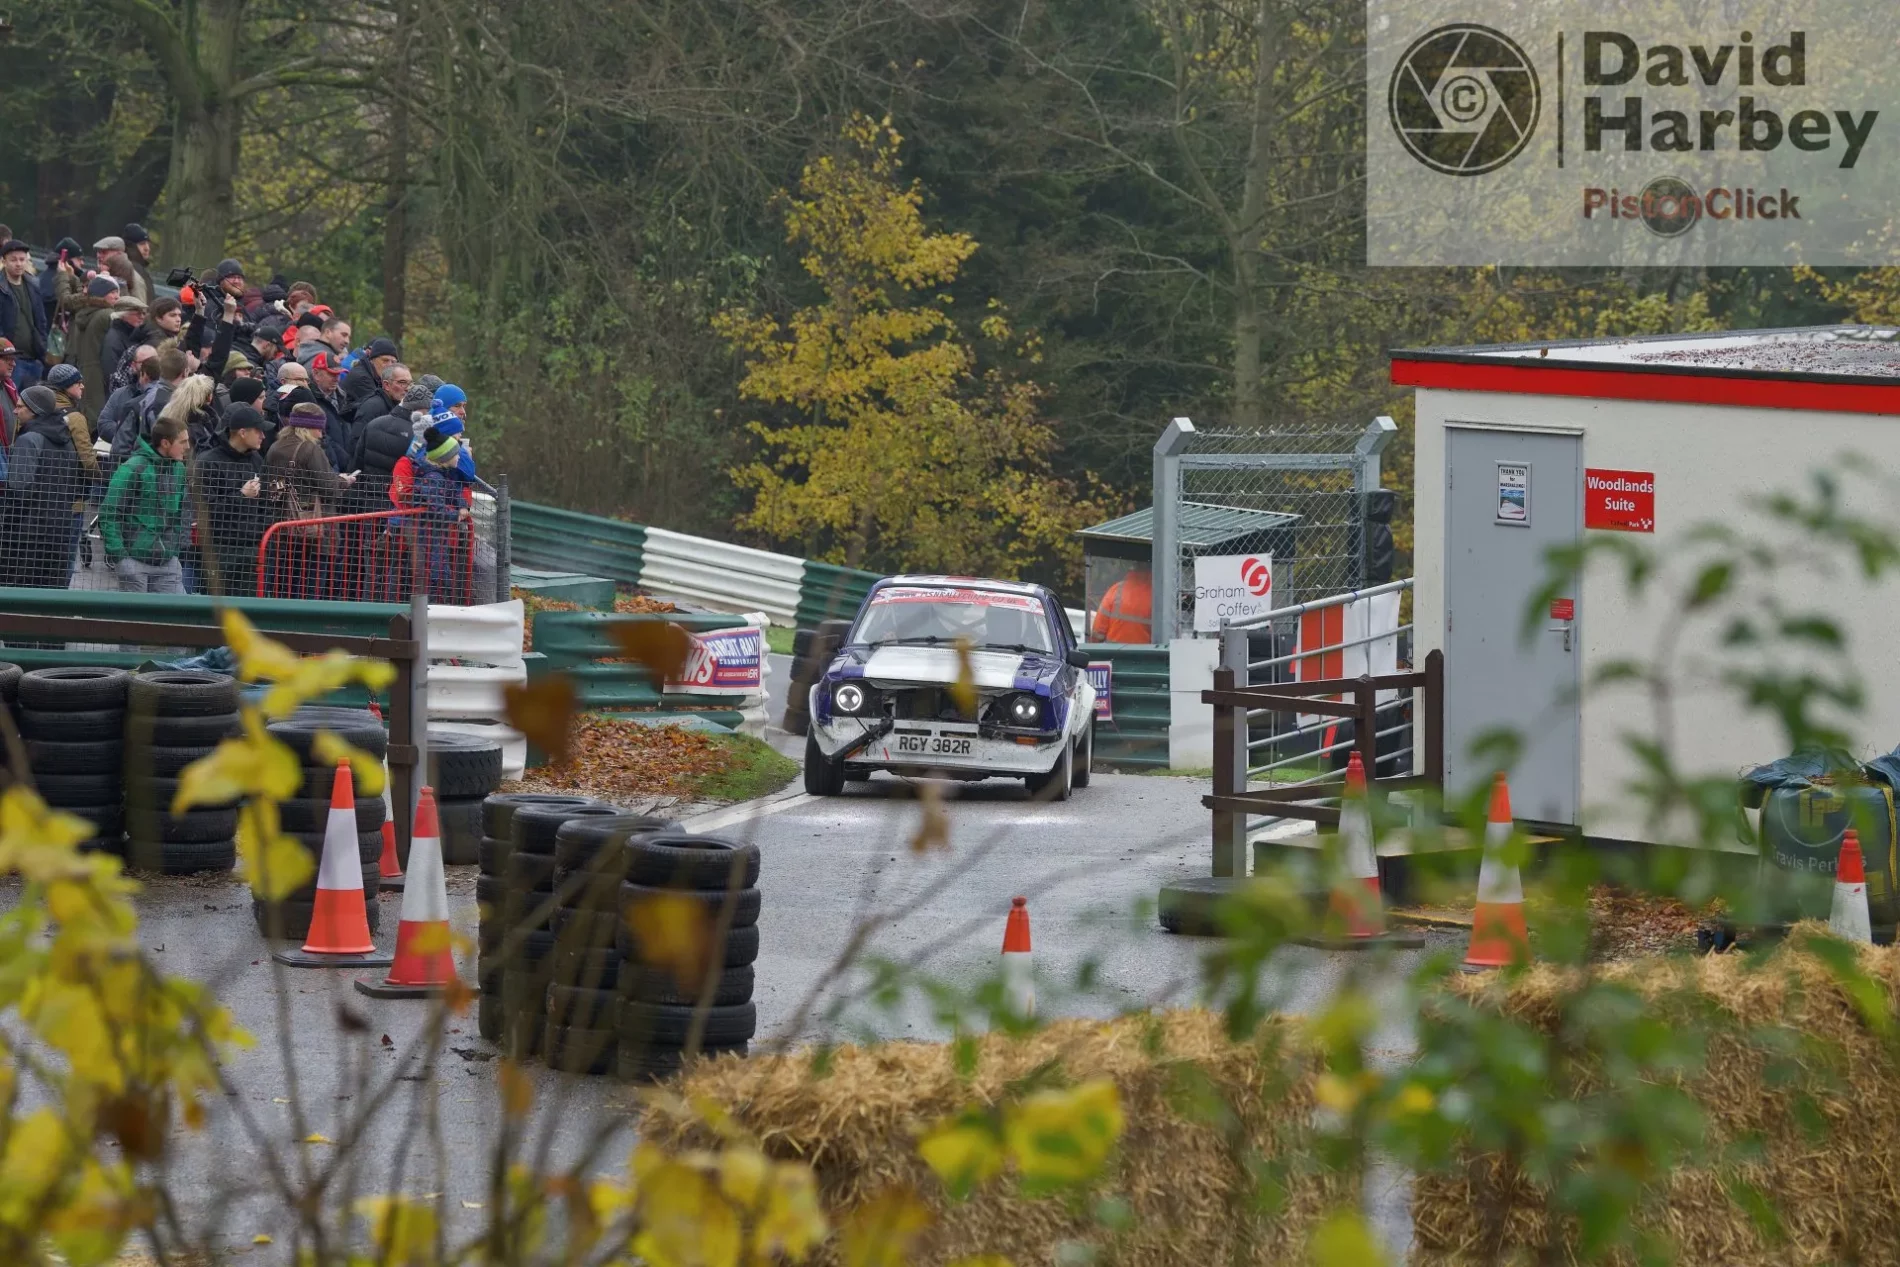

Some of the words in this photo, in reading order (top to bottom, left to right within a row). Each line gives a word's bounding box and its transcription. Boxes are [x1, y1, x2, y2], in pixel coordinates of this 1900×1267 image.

[1587, 476, 1654, 493] Woodlands
[1604, 497, 1636, 512] Suite
[1195, 586, 1245, 600] Graham
[1216, 602, 1258, 617] Coffey
[706, 637, 743, 658] CIRCUIT
[899, 736, 928, 752] RGY
[932, 738, 971, 755] 382R
